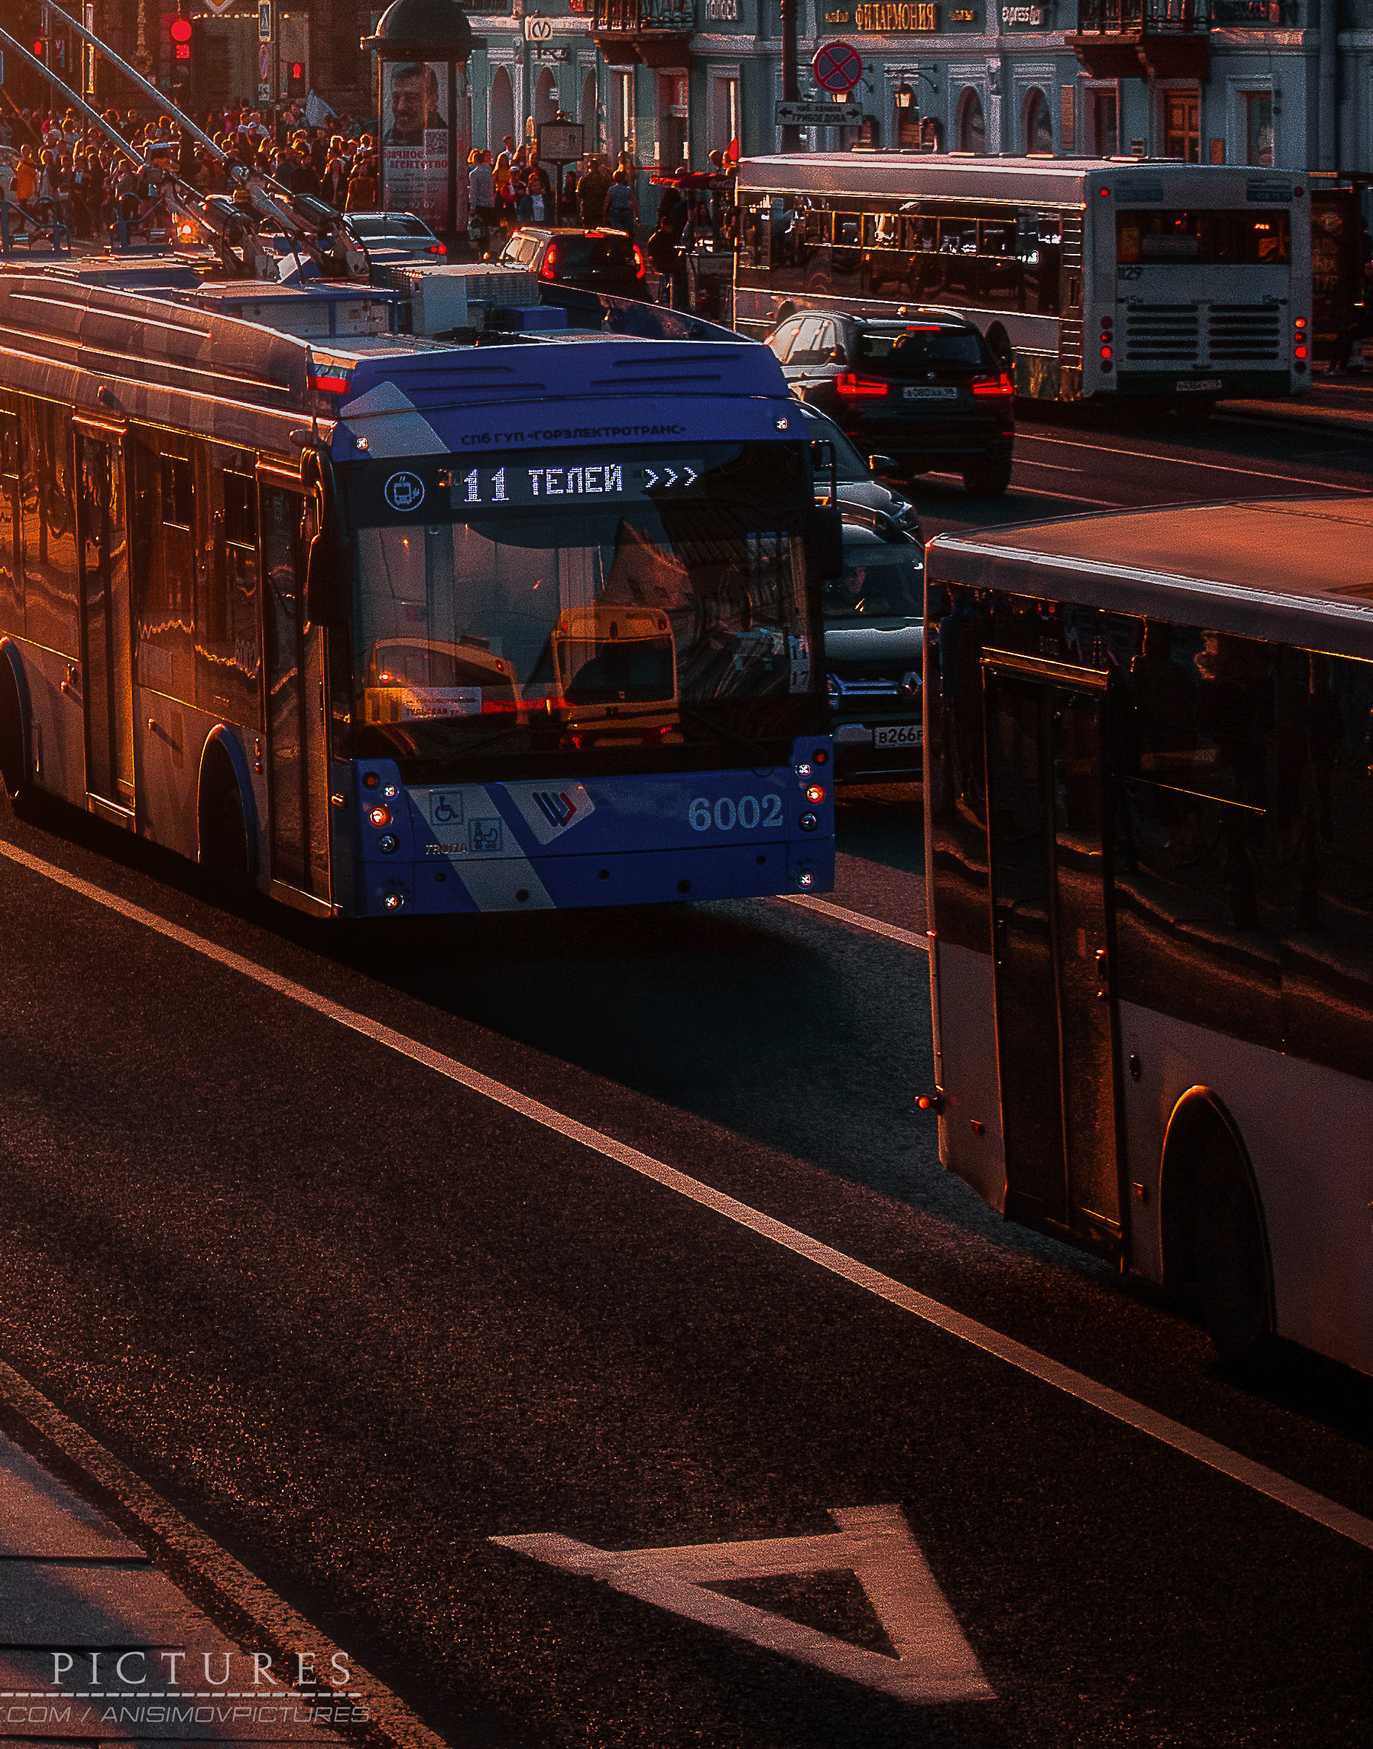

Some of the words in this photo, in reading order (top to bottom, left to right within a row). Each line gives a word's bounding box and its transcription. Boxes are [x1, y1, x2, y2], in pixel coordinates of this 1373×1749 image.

[855, 3, 937, 30] ФИЛАРМОНИЯ
[792, 113, 846, 122] ГРИБОЕДОВА
[494, 432, 524, 443] ГУП
[527, 424, 686, 440] «ГОРЭЛЕКТРОТРАНС»
[463, 467, 510, 502] 11
[528, 463, 622, 495] ТЕЛЕЙ
[687, 793, 784, 831] 6002
